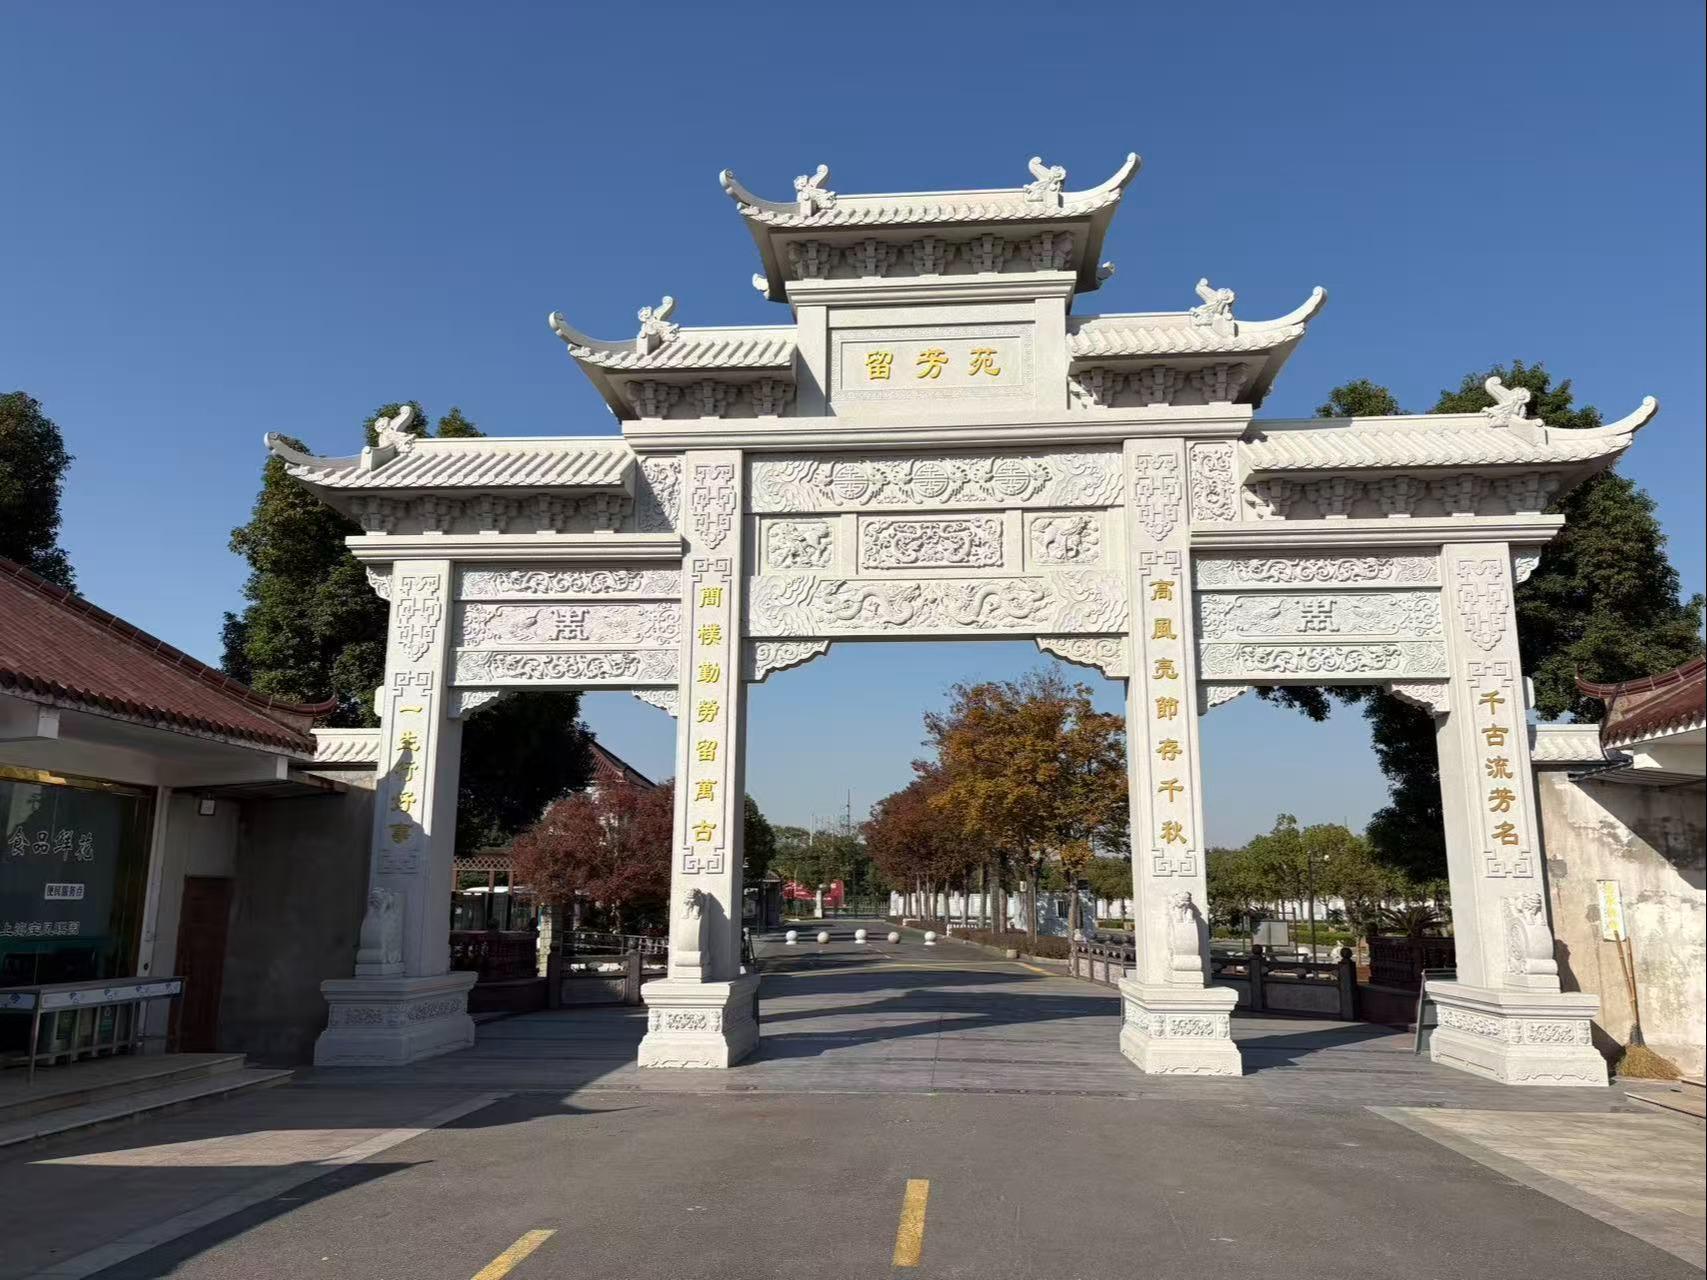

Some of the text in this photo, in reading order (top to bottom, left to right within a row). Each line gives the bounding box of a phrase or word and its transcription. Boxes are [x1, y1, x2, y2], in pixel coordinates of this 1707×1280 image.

[864, 347, 1001, 380] 留芳苑
[1149, 579, 1187, 844] 高風亮節存千秋
[1478, 689, 1519, 845] 千古流芳名
